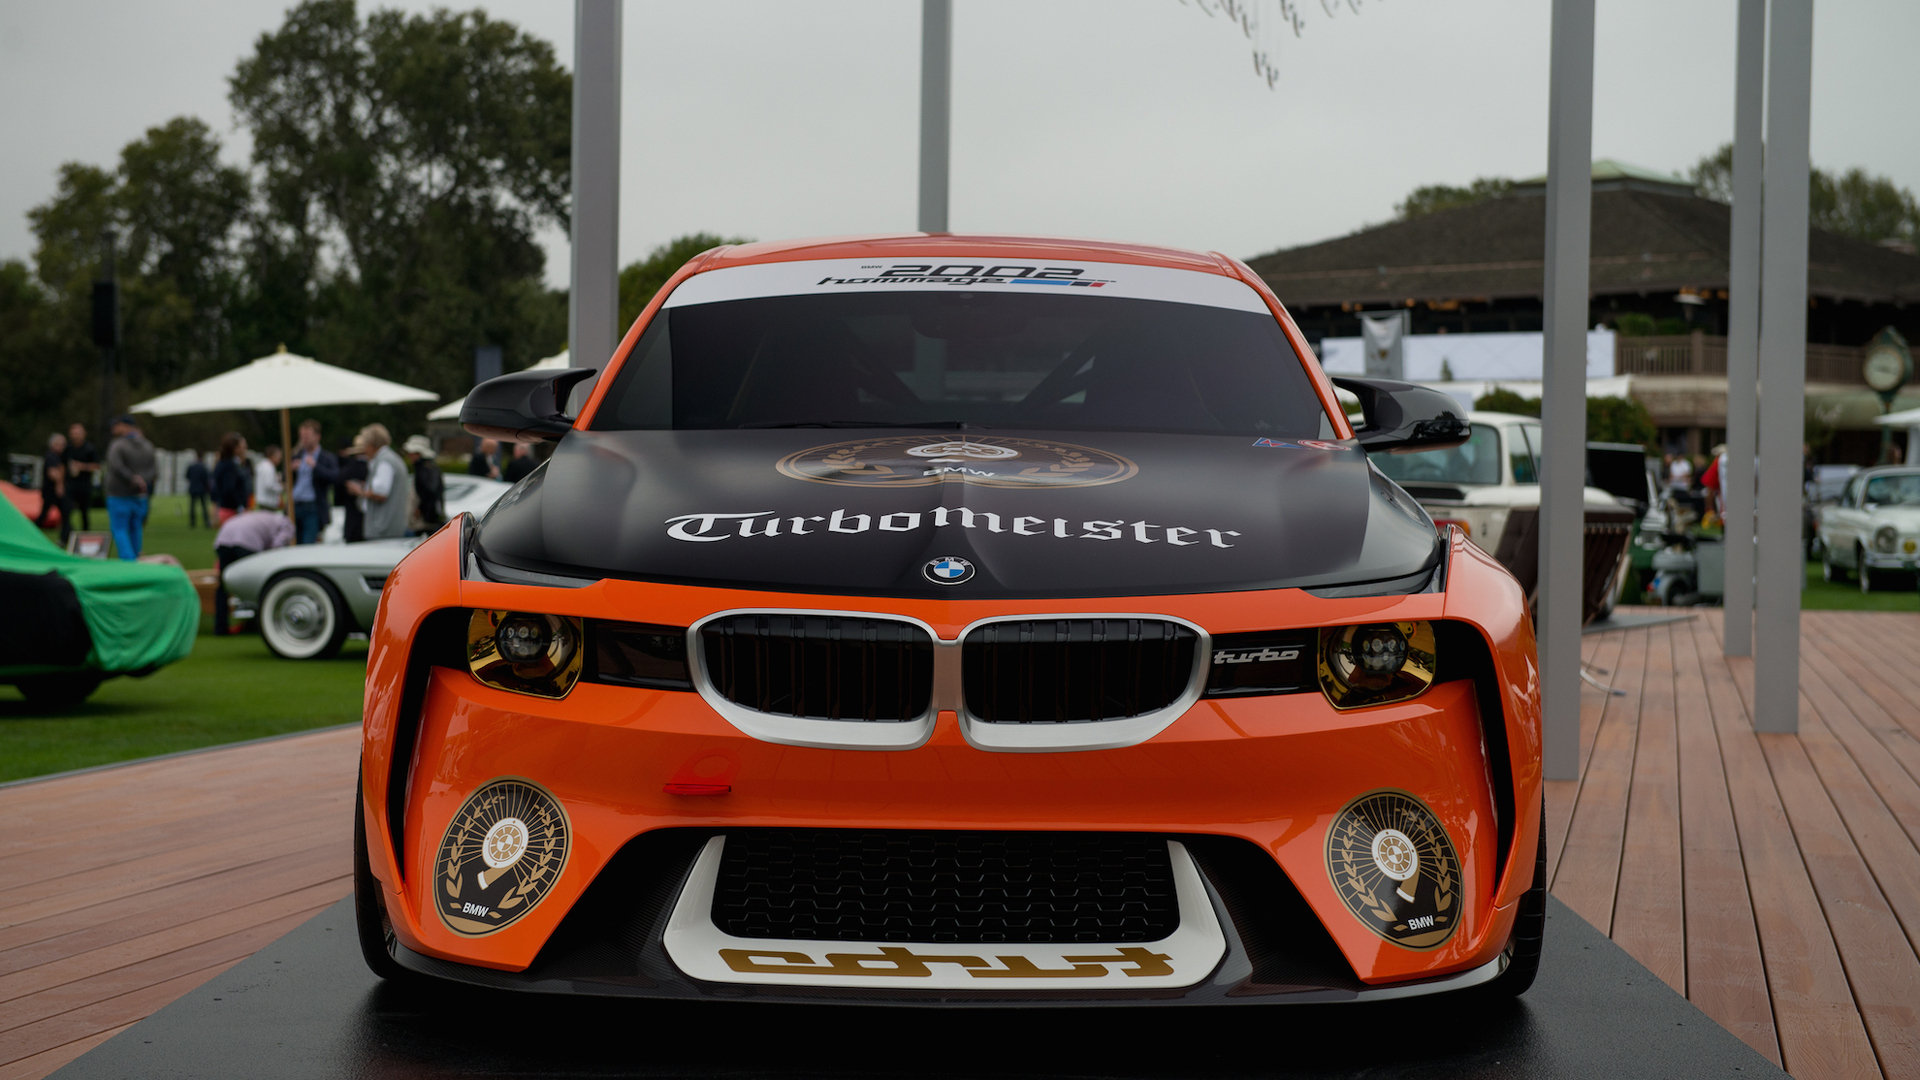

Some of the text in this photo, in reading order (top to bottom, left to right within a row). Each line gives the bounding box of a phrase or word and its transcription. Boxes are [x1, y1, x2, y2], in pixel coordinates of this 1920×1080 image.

[878, 264, 1086, 280] 2002
[816, 276, 1008, 286] hommage
[923, 466, 996, 478] BMW
[664, 506, 1242, 549] Turbomeister
[929, 557, 971, 566] BMW
[1213, 648, 1300, 665] turbo
[462, 902, 490, 918] BMW
[1407, 915, 1434, 931] BMW
